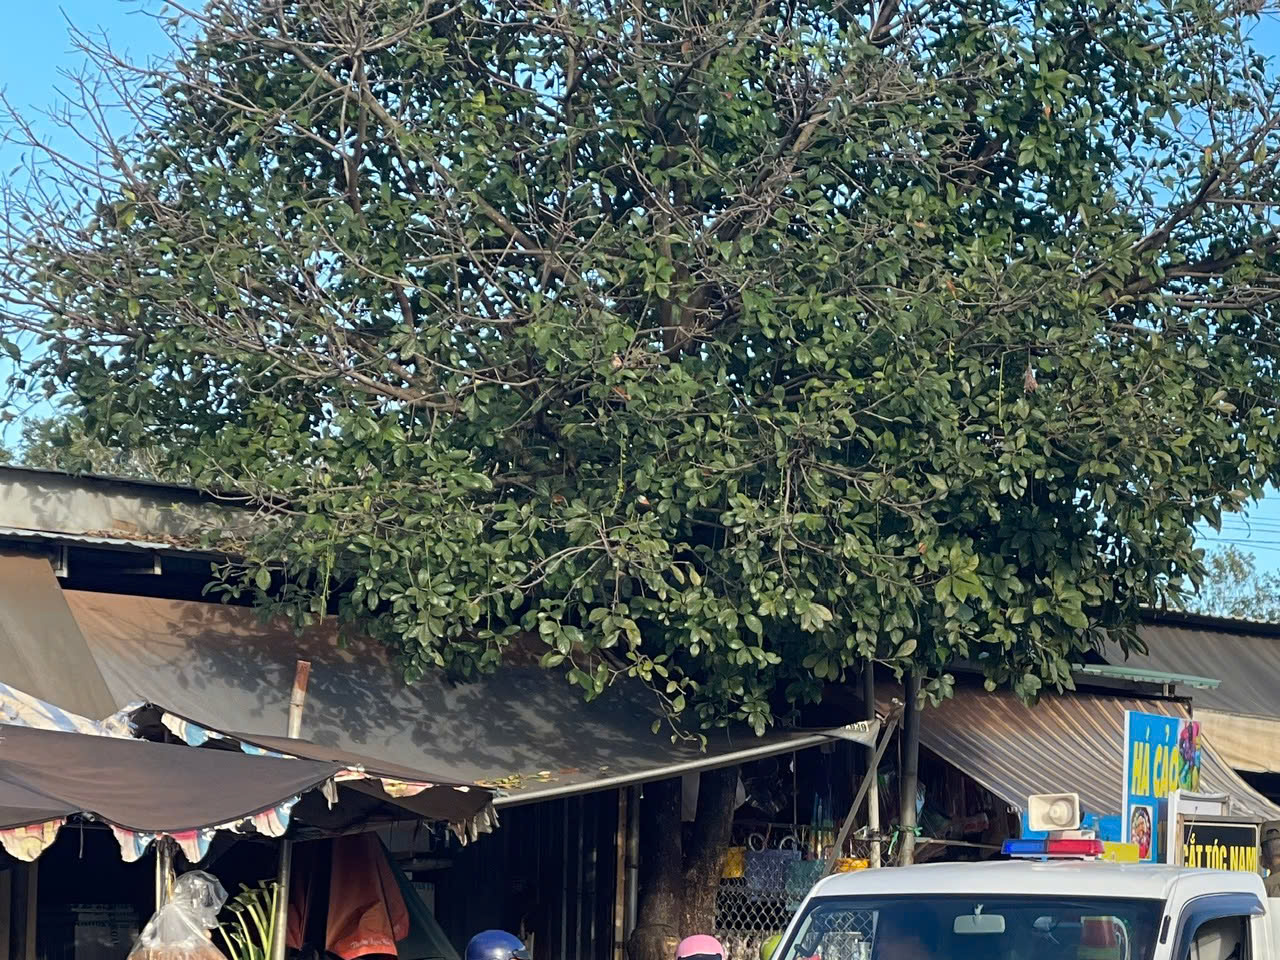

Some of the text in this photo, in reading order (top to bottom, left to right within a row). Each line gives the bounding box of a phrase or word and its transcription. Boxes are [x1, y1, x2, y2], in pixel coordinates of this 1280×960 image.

[1131, 724, 1180, 799] HÁ CẢO
[1205, 838, 1228, 872] TÓC
[1229, 845, 1257, 873] NAM
